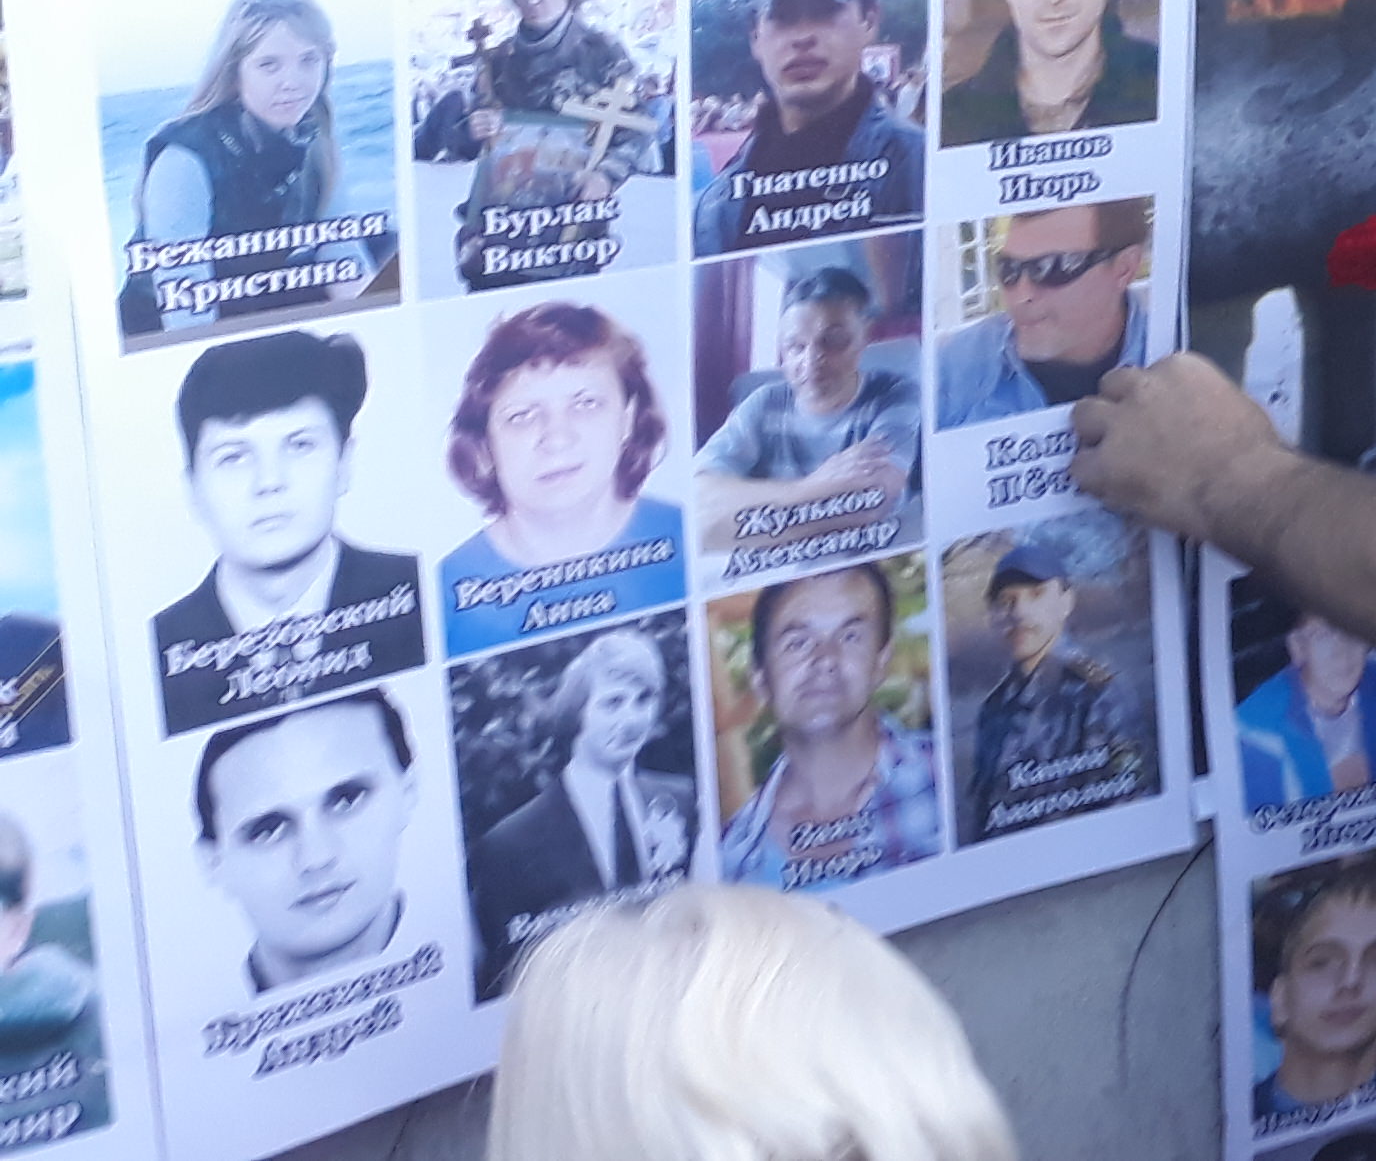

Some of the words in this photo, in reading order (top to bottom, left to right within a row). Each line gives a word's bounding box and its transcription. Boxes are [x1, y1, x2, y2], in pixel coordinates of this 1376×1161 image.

[988, 135, 1113, 170] Иванов
[730, 155, 890, 201] Гнатенко
[1000, 167, 1101, 205] Игорь
[482, 195, 619, 239] Бурлак
[745, 189, 873, 237] Андрей
[125, 210, 389, 276] Бежаницкая
[480, 236, 622, 277] Виктор
[157, 256, 362, 316] Кристина
[984, 429, 1079, 472] Каи
[985, 466, 1081, 510] Пёт
[734, 485, 887, 540] Жульков
[721, 517, 901, 581] Александр
[521, 588, 617, 634] Анна
